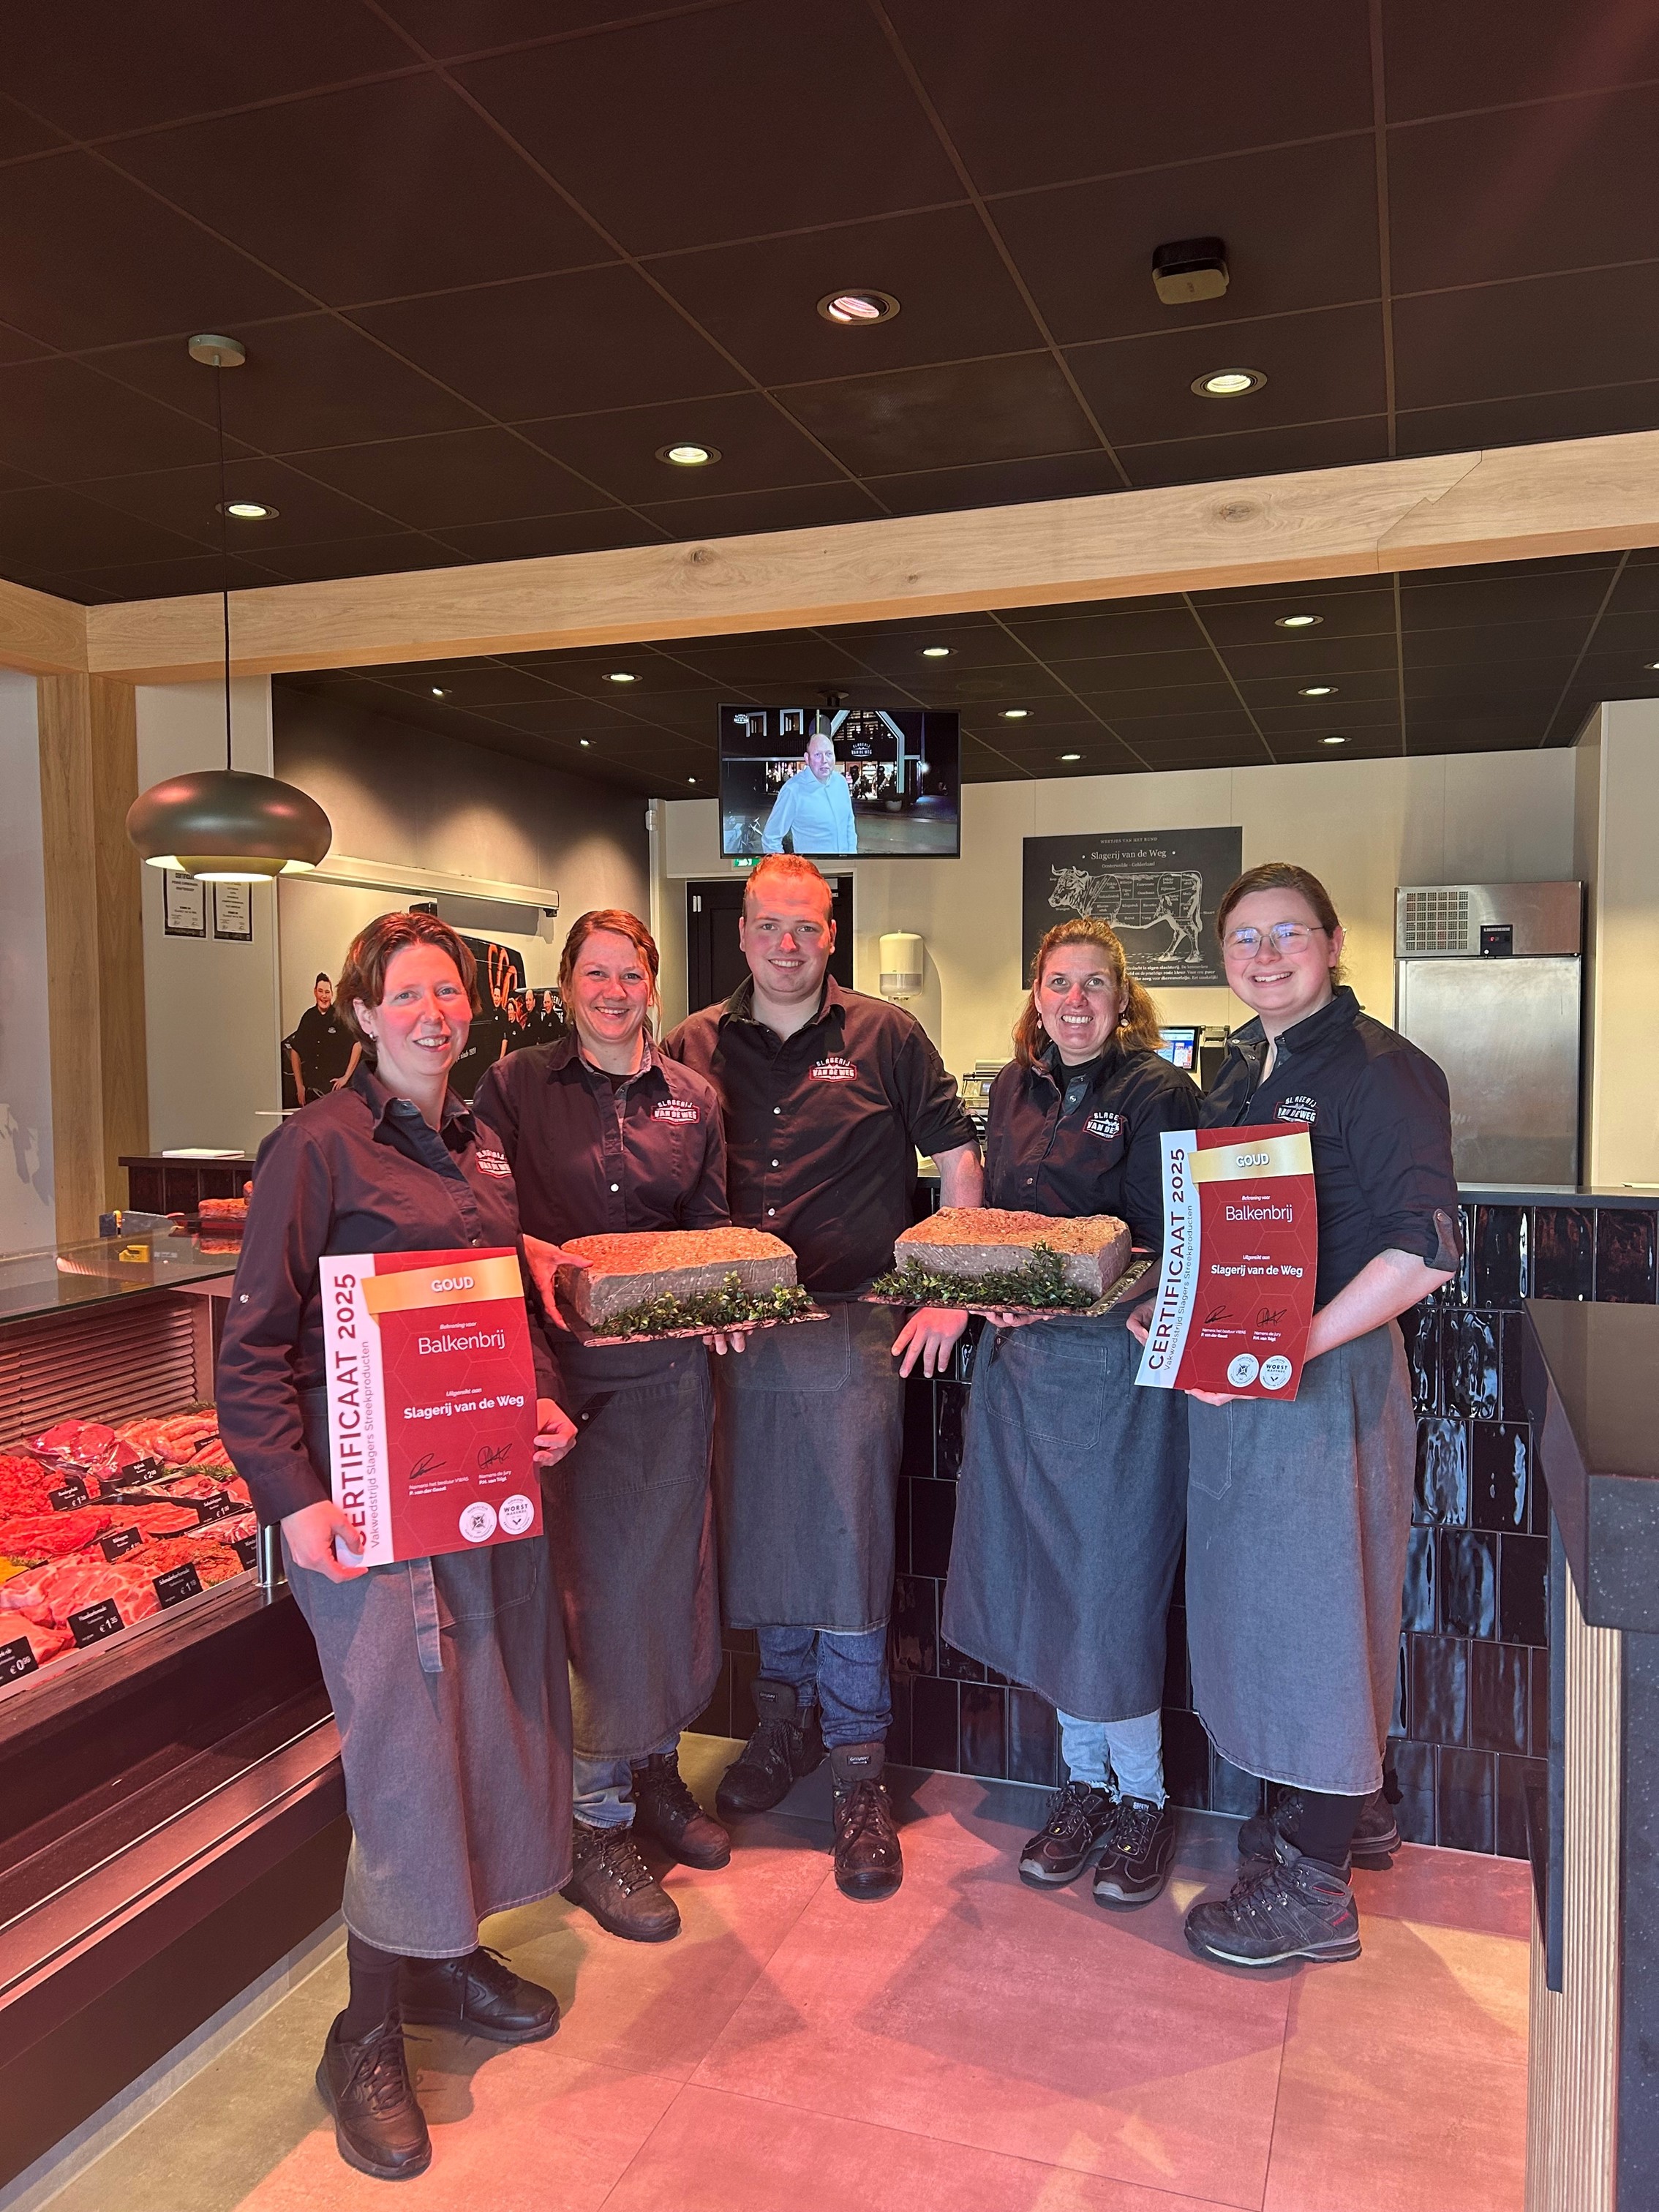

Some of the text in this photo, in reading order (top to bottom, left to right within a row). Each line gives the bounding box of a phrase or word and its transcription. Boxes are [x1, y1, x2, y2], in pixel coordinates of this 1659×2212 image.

[1091, 851, 1121, 861] Slagerij
[1137, 849, 1148, 857] de
[1149, 849, 1167, 859] Weg
[1094, 1112, 1120, 1121] SLAGE
[1086, 1121, 1104, 1132] VAN
[1235, 1153, 1270, 1167] GOUD
[1225, 1204, 1293, 1223] Balkenbrij
[1148, 1148, 1185, 1370] CERTIFICAAT 2025
[1211, 1264, 1304, 1278] Slagerij van de Weg
[431, 1276, 475, 1293] GOUD
[1164, 1205, 1194, 1371] Vakwedstrijd Slagers Streekproducten
[418, 1329, 505, 1355] Balkenbrij
[334, 1274, 366, 1546] ERTIFICAAT 2025
[403, 1394, 524, 1420] Slagerij van de Weg
[361, 1341, 380, 1549] Vakwedstrijd Slagers Streekproducten
[503, 1503, 528, 1513] WORST
